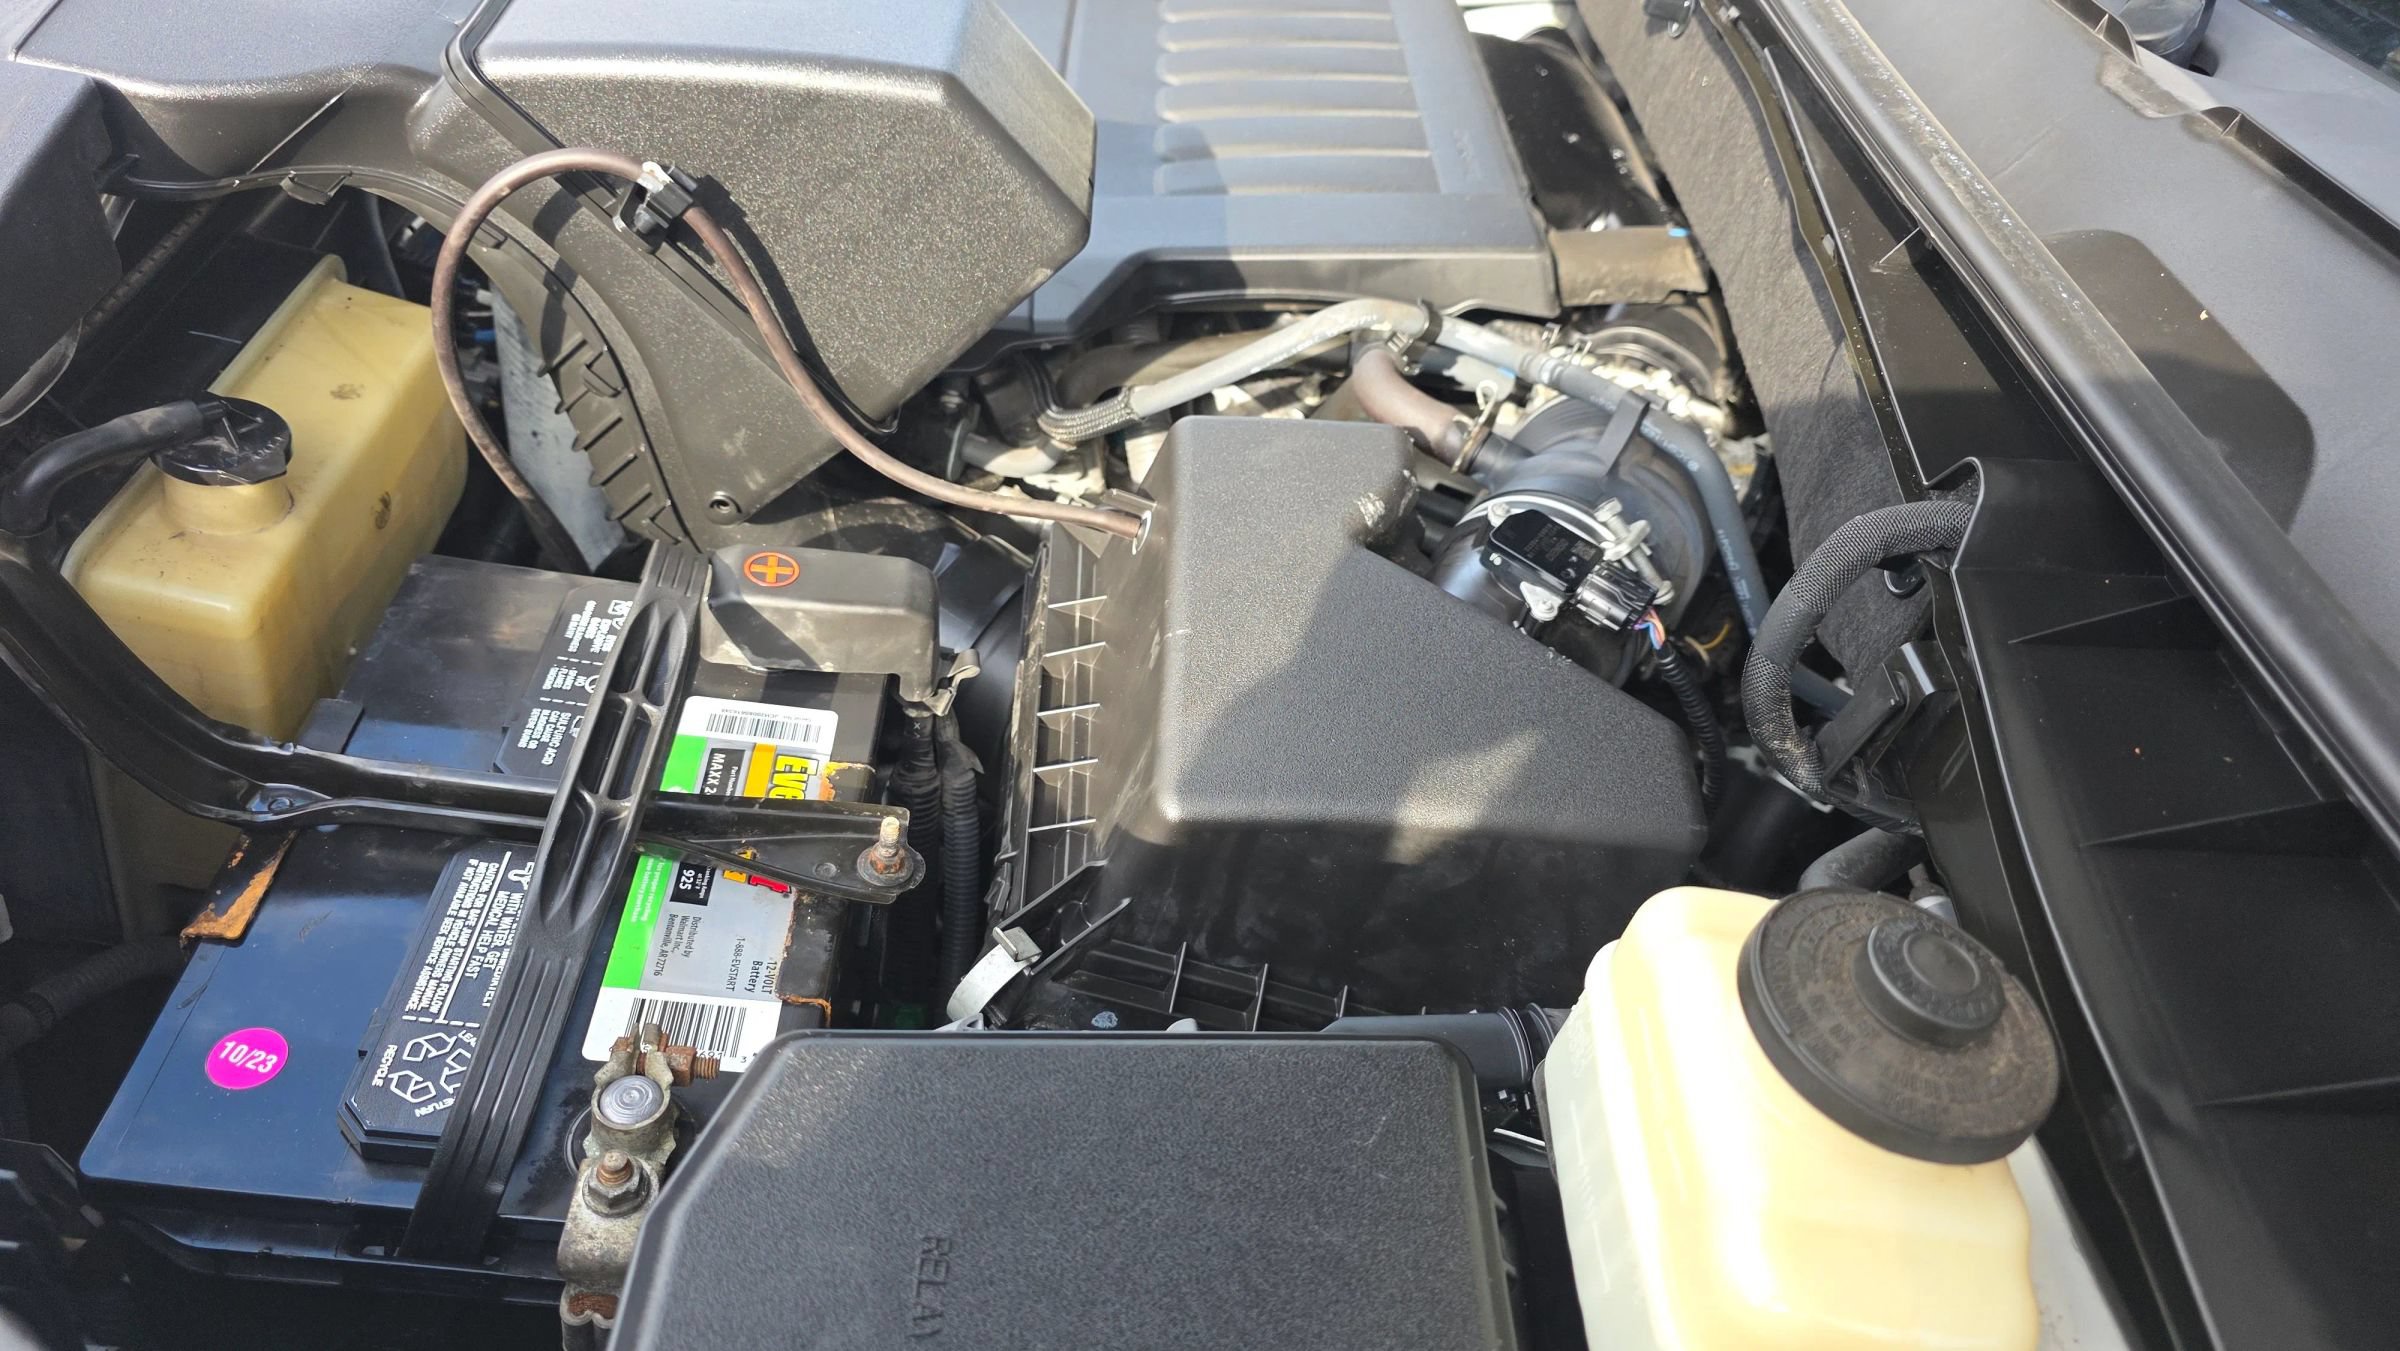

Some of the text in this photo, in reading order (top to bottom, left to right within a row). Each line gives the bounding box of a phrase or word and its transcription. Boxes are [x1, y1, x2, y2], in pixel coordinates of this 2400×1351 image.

[574, 676, 587, 686] NO
[540, 711, 560, 742] CAN CAUSE
[541, 713, 571, 765] SULFURIC ACID
[527, 740, 538, 749] OR
[703, 752, 726, 796] MAXX 2
[731, 766, 739, 777] Part
[461, 862, 489, 908] INSTRUCTIONS
[462, 867, 474, 881] NOT
[639, 871, 651, 893] battery
[679, 869, 695, 890] 925
[447, 882, 469, 916] AVAILABLE
[474, 894, 487, 908] FOR
[504, 893, 524, 914] WITH
[438, 917, 455, 934] SEEK
[465, 909, 481, 927] SAFE
[675, 916, 690, 940] Walmart
[445, 919, 465, 947] VEHICLE
[457, 927, 472, 946] JUMP
[465, 891, 510, 979] MEDICAL HELP FAST
[653, 914, 679, 976] Bentonville, AR 72716
[681, 917, 702, 958] Distributed by
[425, 936, 445, 965] SERVICE
[432, 948, 453, 978] OWNERS
[442, 948, 465, 982] STARTING
[483, 951, 501, 970] GET
[726, 937, 745, 992] 1-888-EVSTART
[744, 960, 763, 993] Battery
[761, 961, 777, 994] 12-VOLT
[429, 984, 449, 1013] FOLLOW
[458, 1030, 477, 1047] LEA
[218, 1040, 278, 1073] 10/23
[372, 1045, 398, 1087] RECYCLE
[415, 1096, 456, 1117] ETURN
